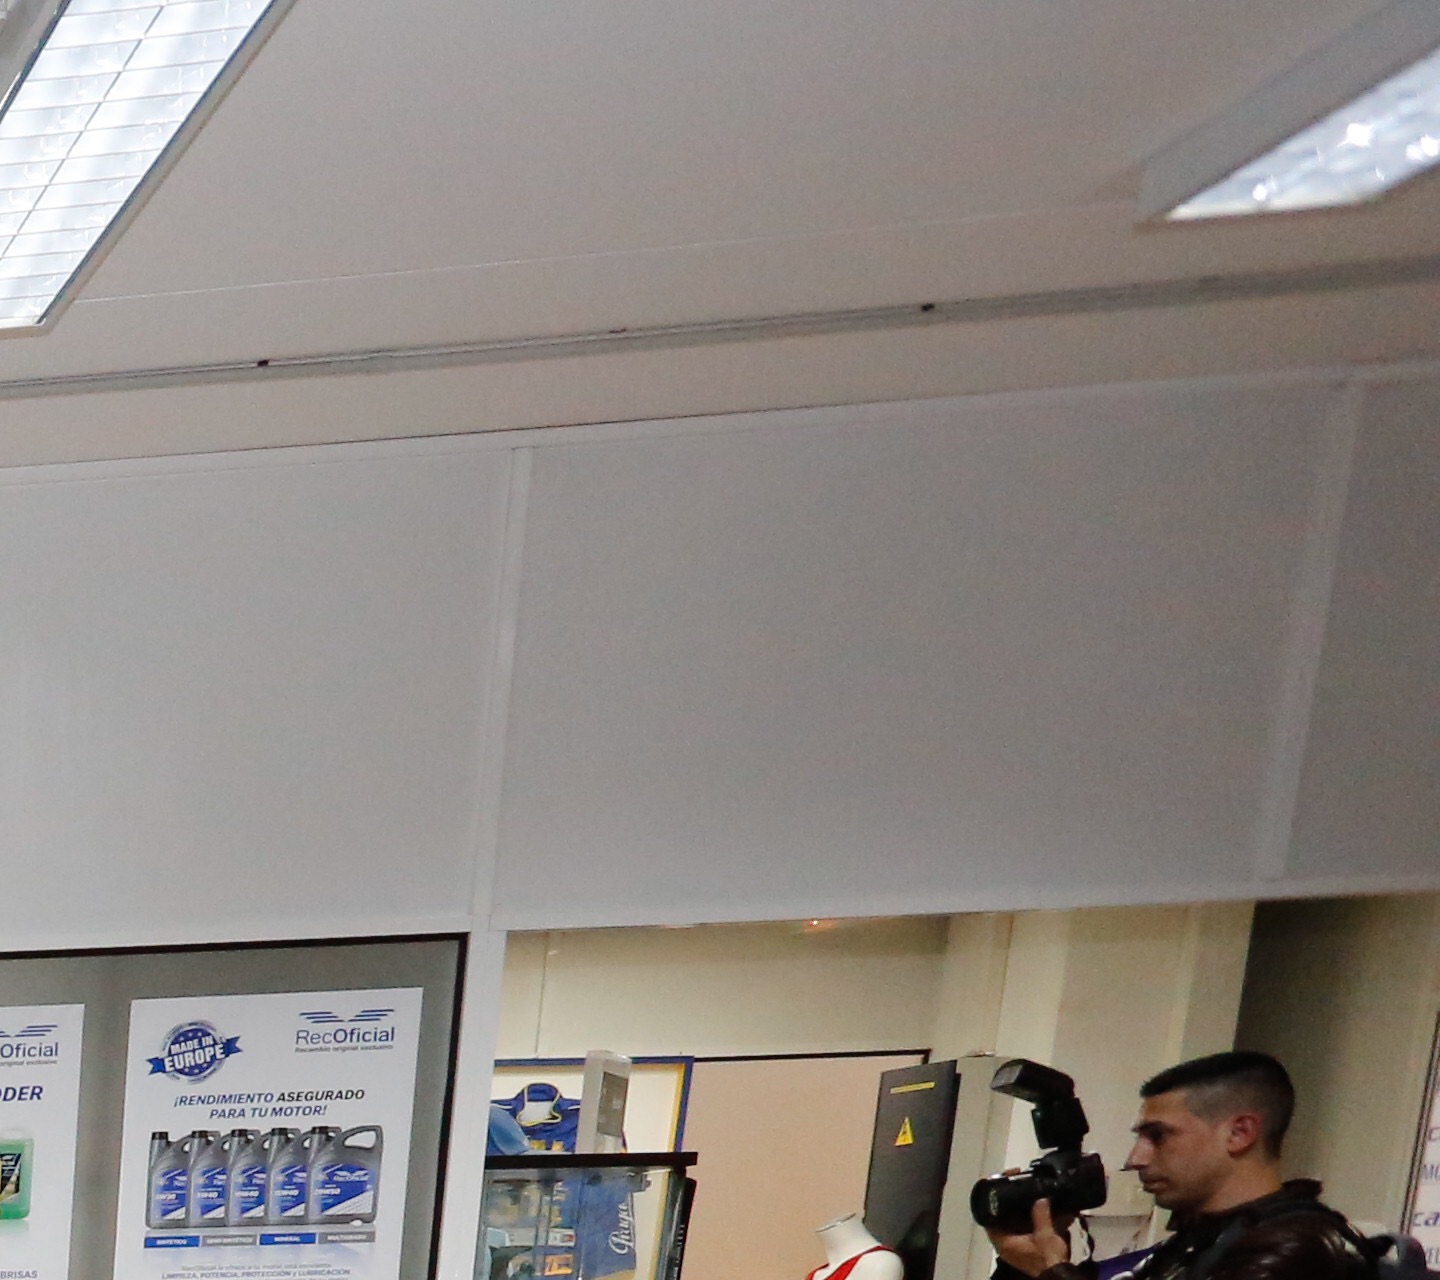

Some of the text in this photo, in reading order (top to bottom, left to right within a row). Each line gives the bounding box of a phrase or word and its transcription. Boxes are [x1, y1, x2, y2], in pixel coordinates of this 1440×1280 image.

[295, 1027, 395, 1045] RecOficial
[170, 1036, 214, 1057] MADE IN
[164, 1044, 224, 1072] EUROPE
[173, 1089, 365, 1108] ¡RENDIMIENTO ASEGURADO
[209, 1105, 328, 1120] PARA TU MOTOR!
